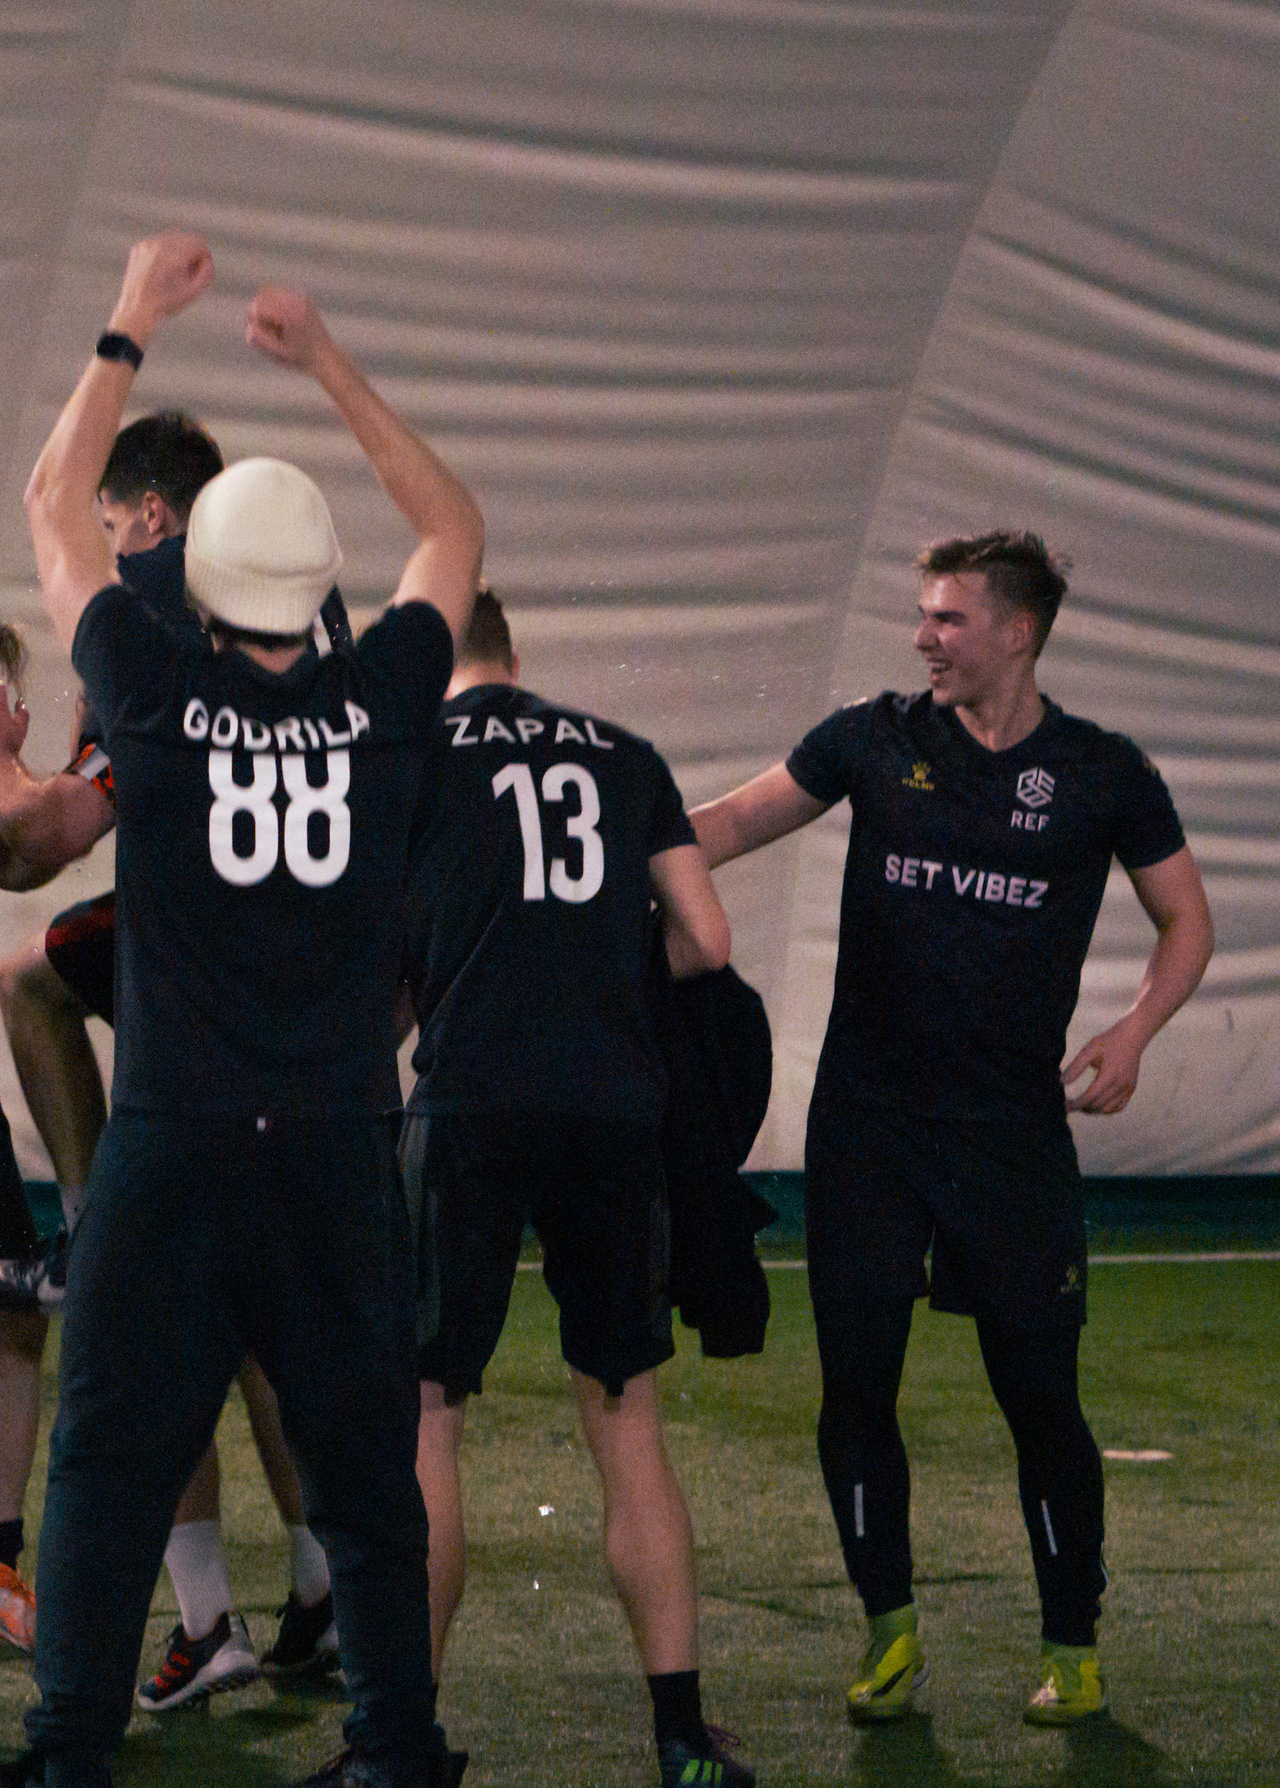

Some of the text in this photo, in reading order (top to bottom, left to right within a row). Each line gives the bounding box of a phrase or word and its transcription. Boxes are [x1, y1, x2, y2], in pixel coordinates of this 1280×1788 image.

[445, 715, 614, 750] ZAPAL
[209, 749, 352, 887] 88
[492, 762, 604, 903] 13
[1011, 810, 1050, 832] REF
[885, 854, 1049, 908] SET VIBEZ
